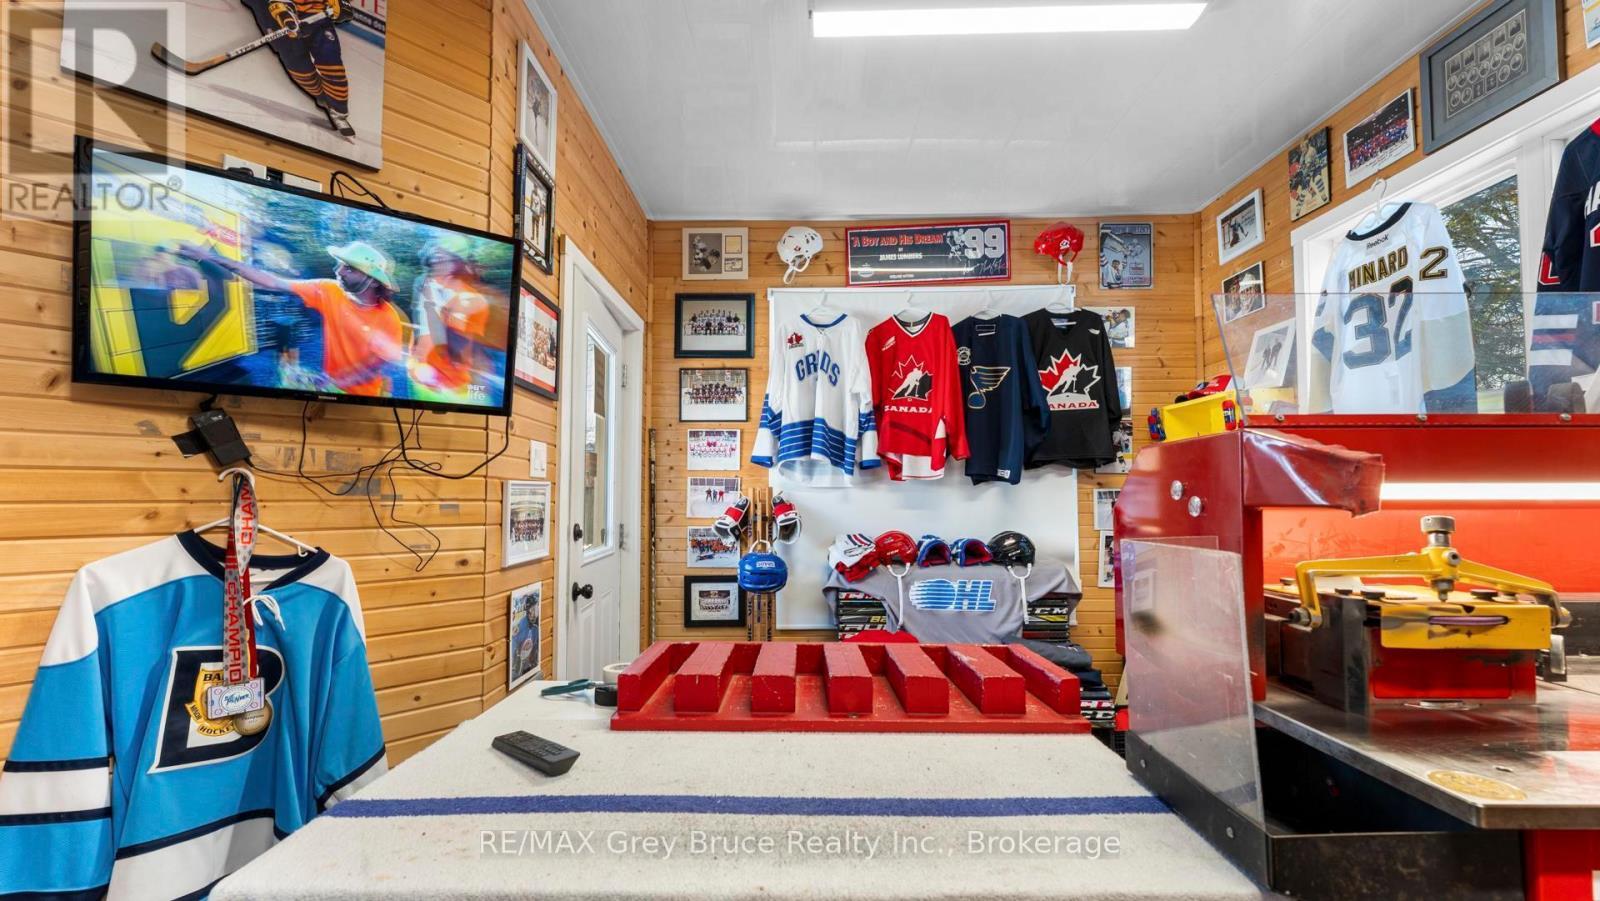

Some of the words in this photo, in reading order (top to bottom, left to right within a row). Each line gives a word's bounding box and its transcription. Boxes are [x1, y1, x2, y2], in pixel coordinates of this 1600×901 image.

[964, 227, 1005, 259] 99
[1366, 234, 1389, 250] Reebok
[1342, 275, 1414, 370] 32
[1048, 401, 1097, 410] ANADA
[909, 579, 997, 612] OHL
[203, 673, 224, 682] BA
